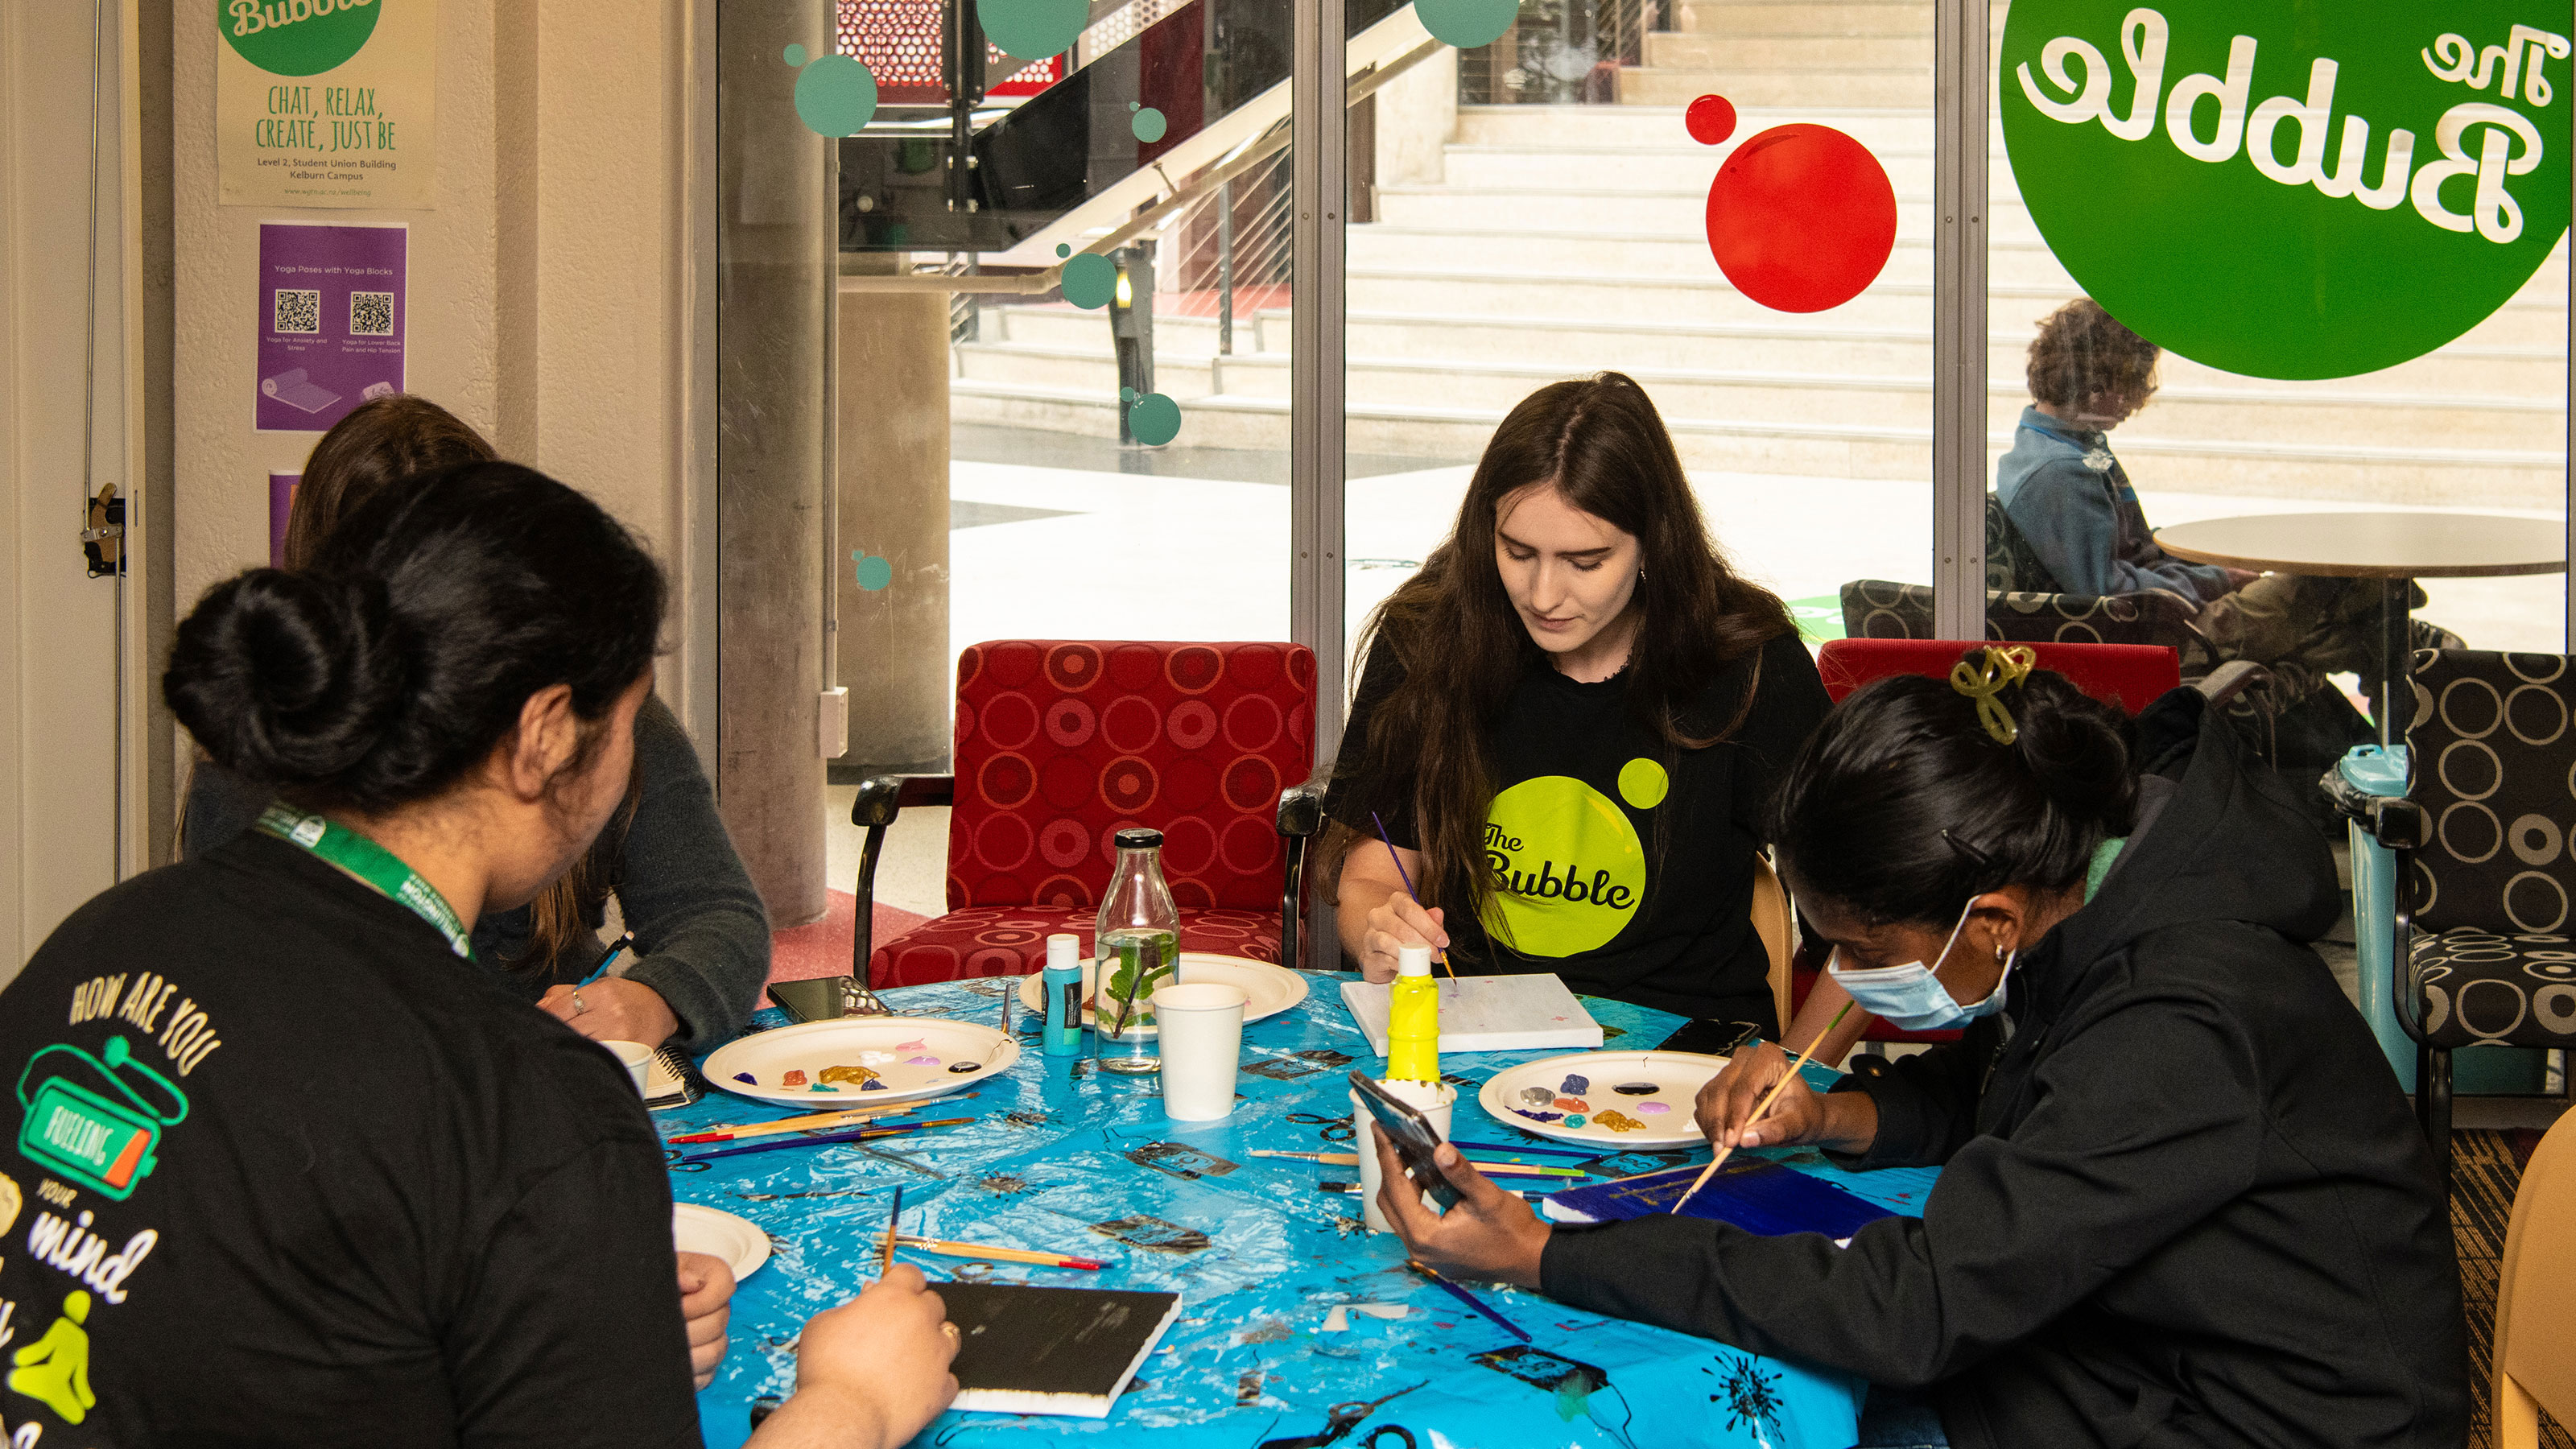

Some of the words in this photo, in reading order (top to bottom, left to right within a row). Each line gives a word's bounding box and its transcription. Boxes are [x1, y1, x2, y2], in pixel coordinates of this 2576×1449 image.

[268, 85, 319, 119] CHAT,
[325, 87, 383, 120] RELAX,
[256, 119, 324, 152] CREATE,
[330, 121, 372, 152] JUST
[378, 122, 396, 151] BE
[258, 158, 280, 167] Level
[283, 159, 291, 168] 2,
[292, 159, 328, 167] Student
[330, 159, 357, 168] Union
[360, 160, 397, 171] Building
[290, 171, 325, 180] Kelburn
[327, 171, 364, 182] Campus
[275, 265, 296, 275] Yoga
[298, 266, 322, 274] Poses
[345, 267, 365, 276] Yoga
[366, 267, 394, 275] Blocks
[292, 336, 315, 345] Anxiety
[1484, 822, 1524, 852] The
[1486, 850, 1635, 910] Bubble
[69, 972, 128, 1026] HOW
[118, 971, 178, 1034] ARE
[158, 997, 221, 1077] YOU
[35, 1178, 78, 1208] YOUR
[27, 1209, 159, 1305] mind
